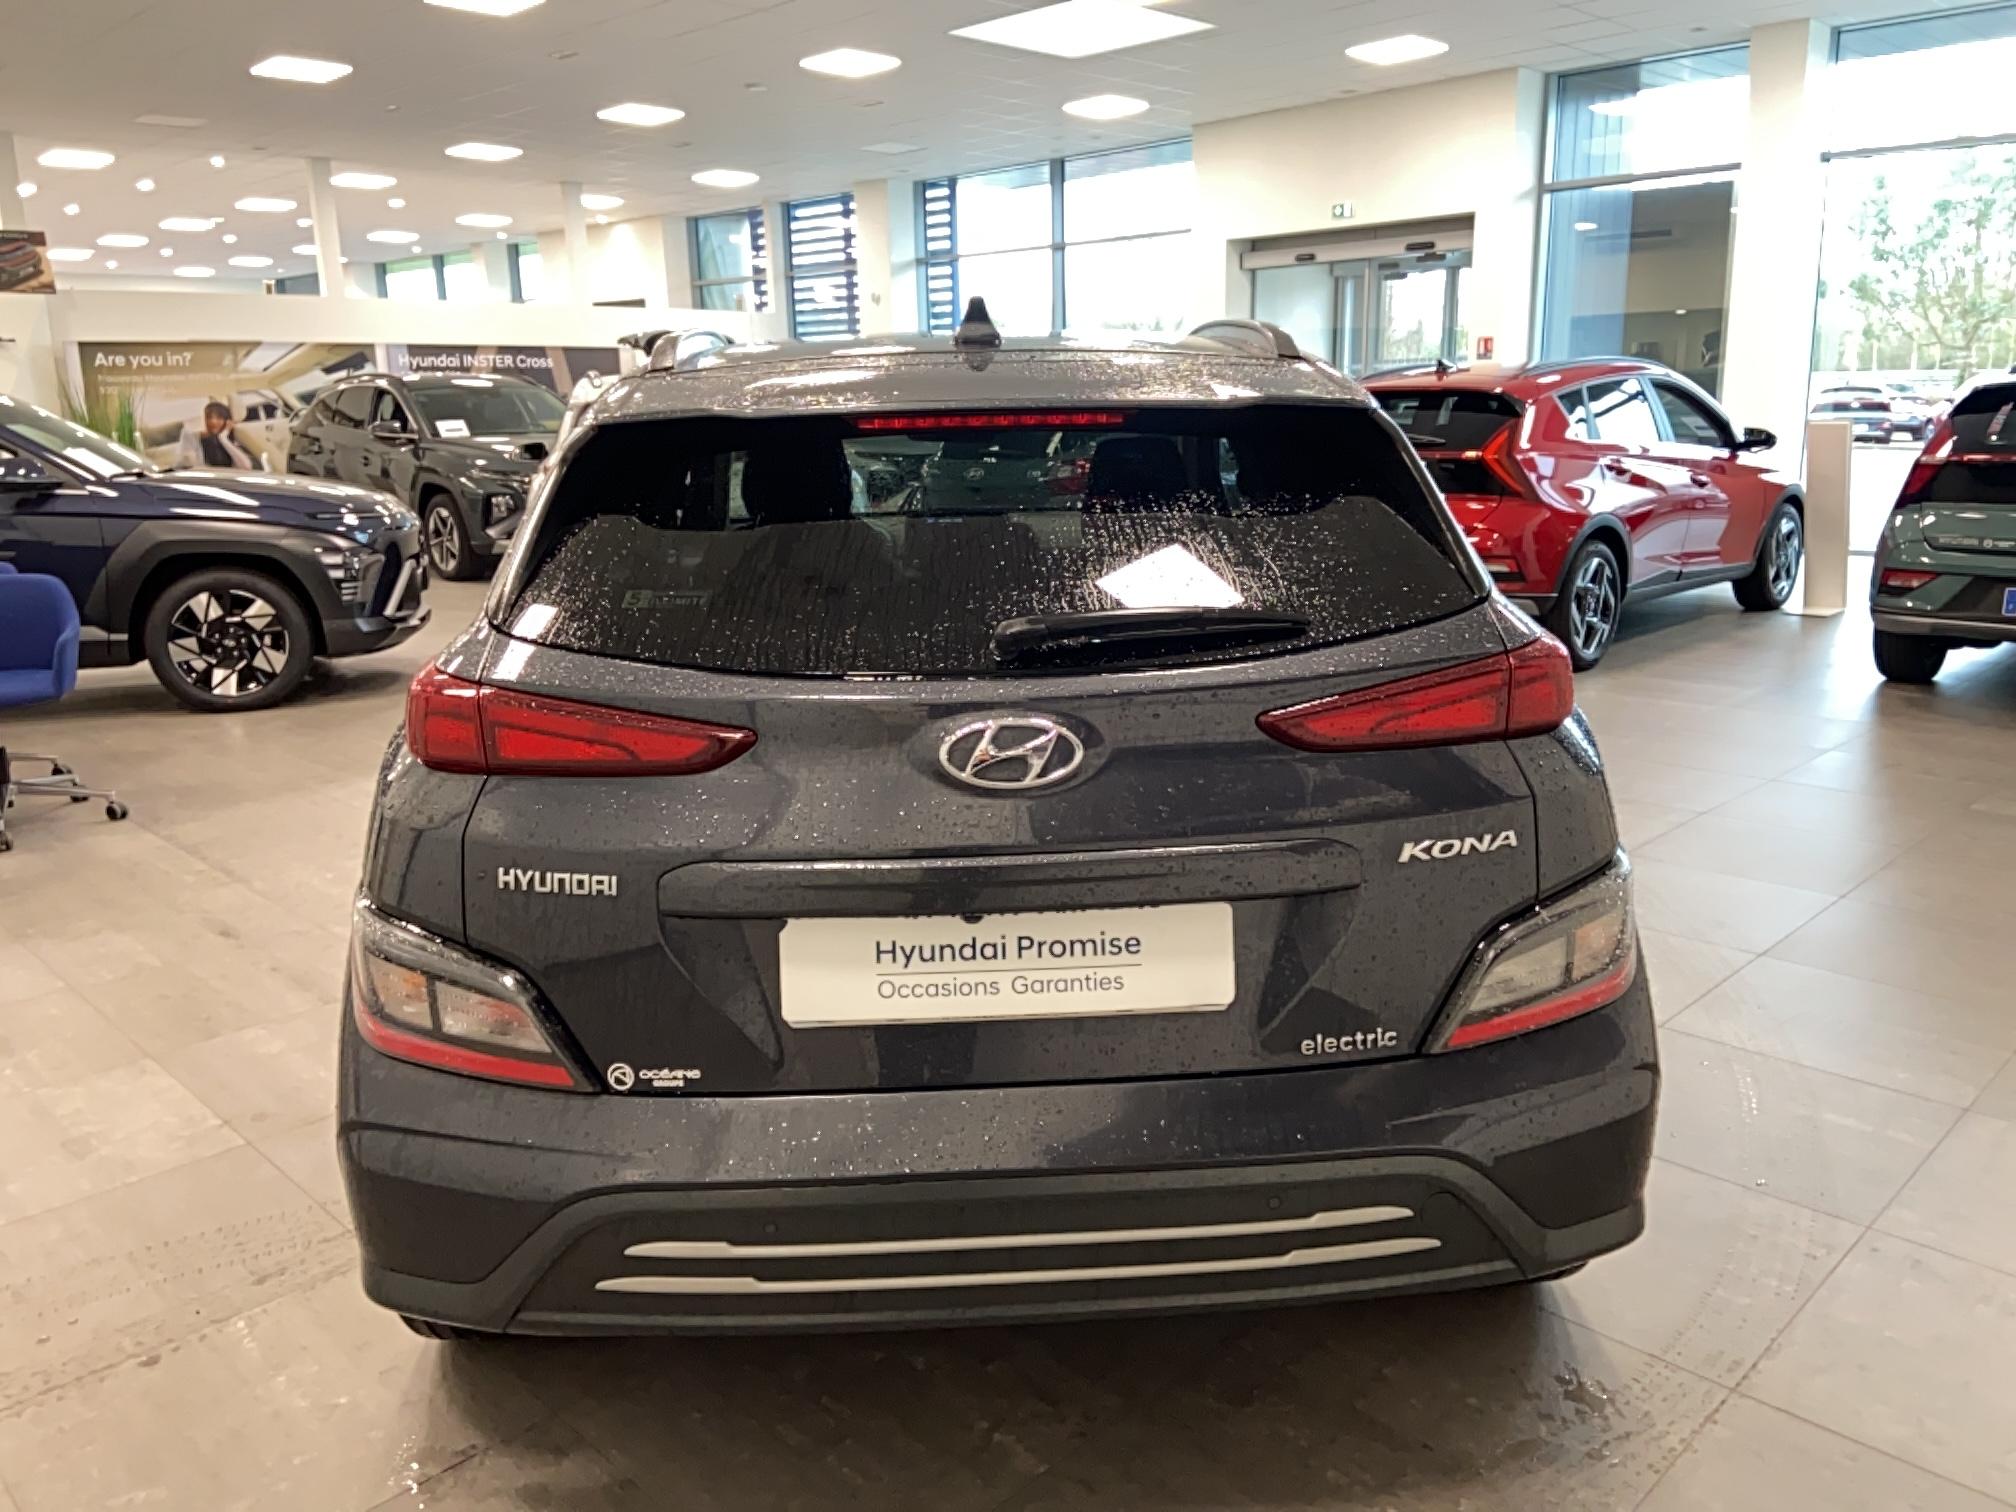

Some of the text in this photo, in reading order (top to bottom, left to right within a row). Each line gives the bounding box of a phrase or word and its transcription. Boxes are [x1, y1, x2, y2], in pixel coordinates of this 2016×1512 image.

[94, 351, 194, 370] Are you in?
[398, 353, 555, 369] Hyundai INSTER Cross
[1397, 828, 1518, 864] KONA
[497, 866, 618, 896] HYUNDAI
[875, 930, 1142, 969] Hyundai Promise
[877, 971, 1126, 999] Occasions Garanties
[1300, 1027, 1398, 1055] electric
